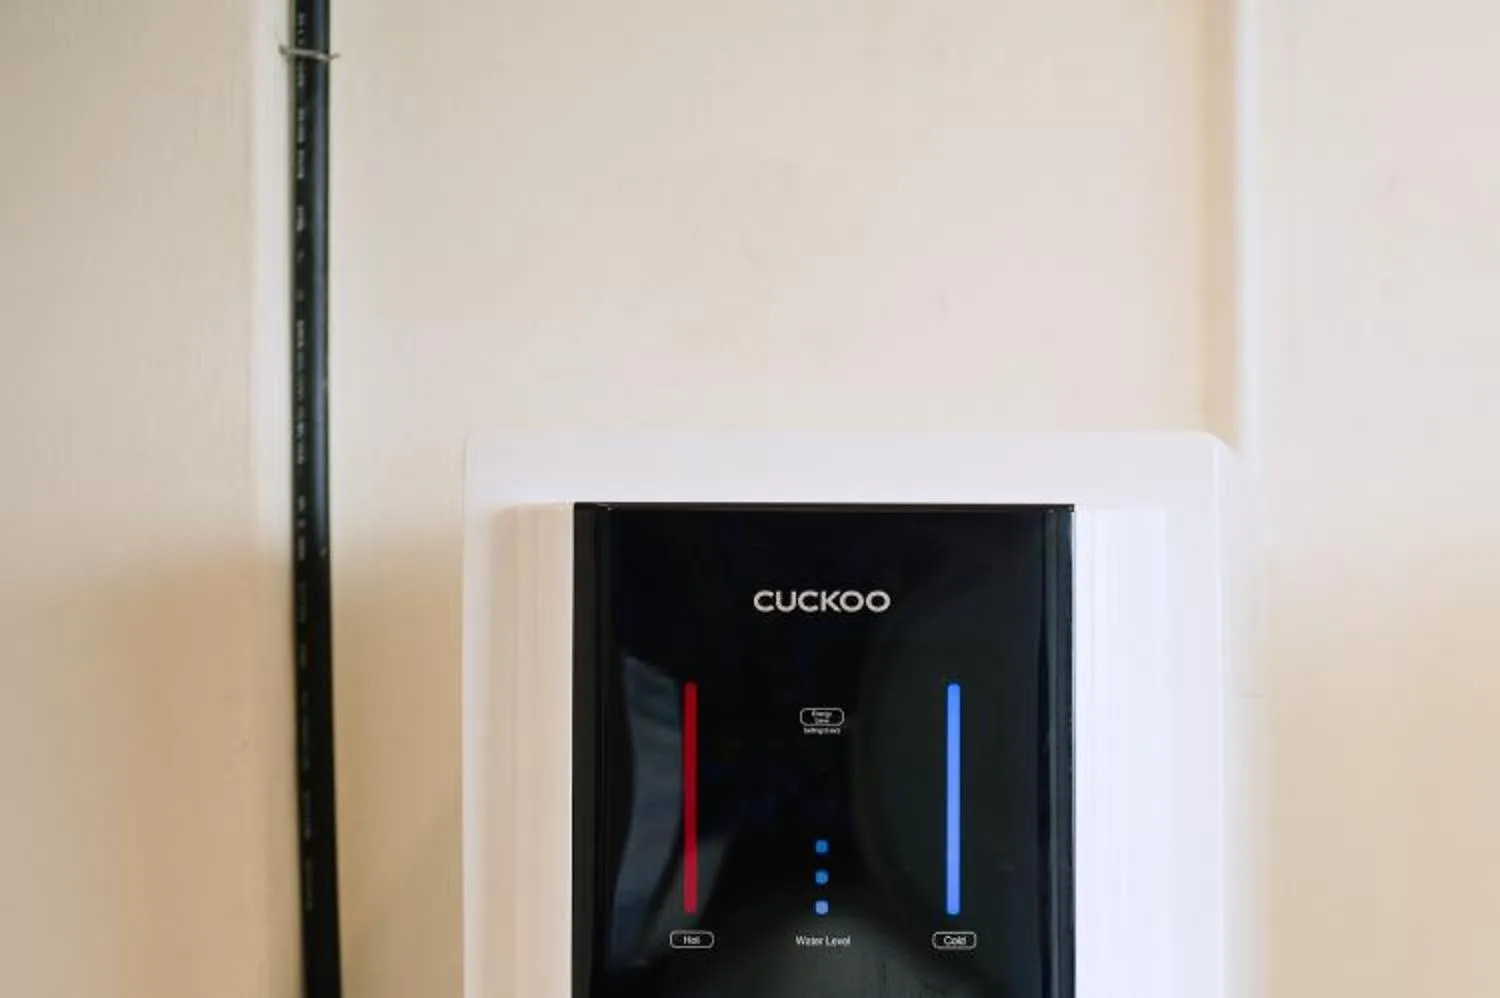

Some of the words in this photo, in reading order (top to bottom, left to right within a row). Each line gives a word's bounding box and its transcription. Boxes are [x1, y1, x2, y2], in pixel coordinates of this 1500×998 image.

[753, 590, 891, 613] CUCKOO
[795, 935, 823, 946] Water
[825, 935, 851, 946] Level
[943, 935, 967, 946] Cold
